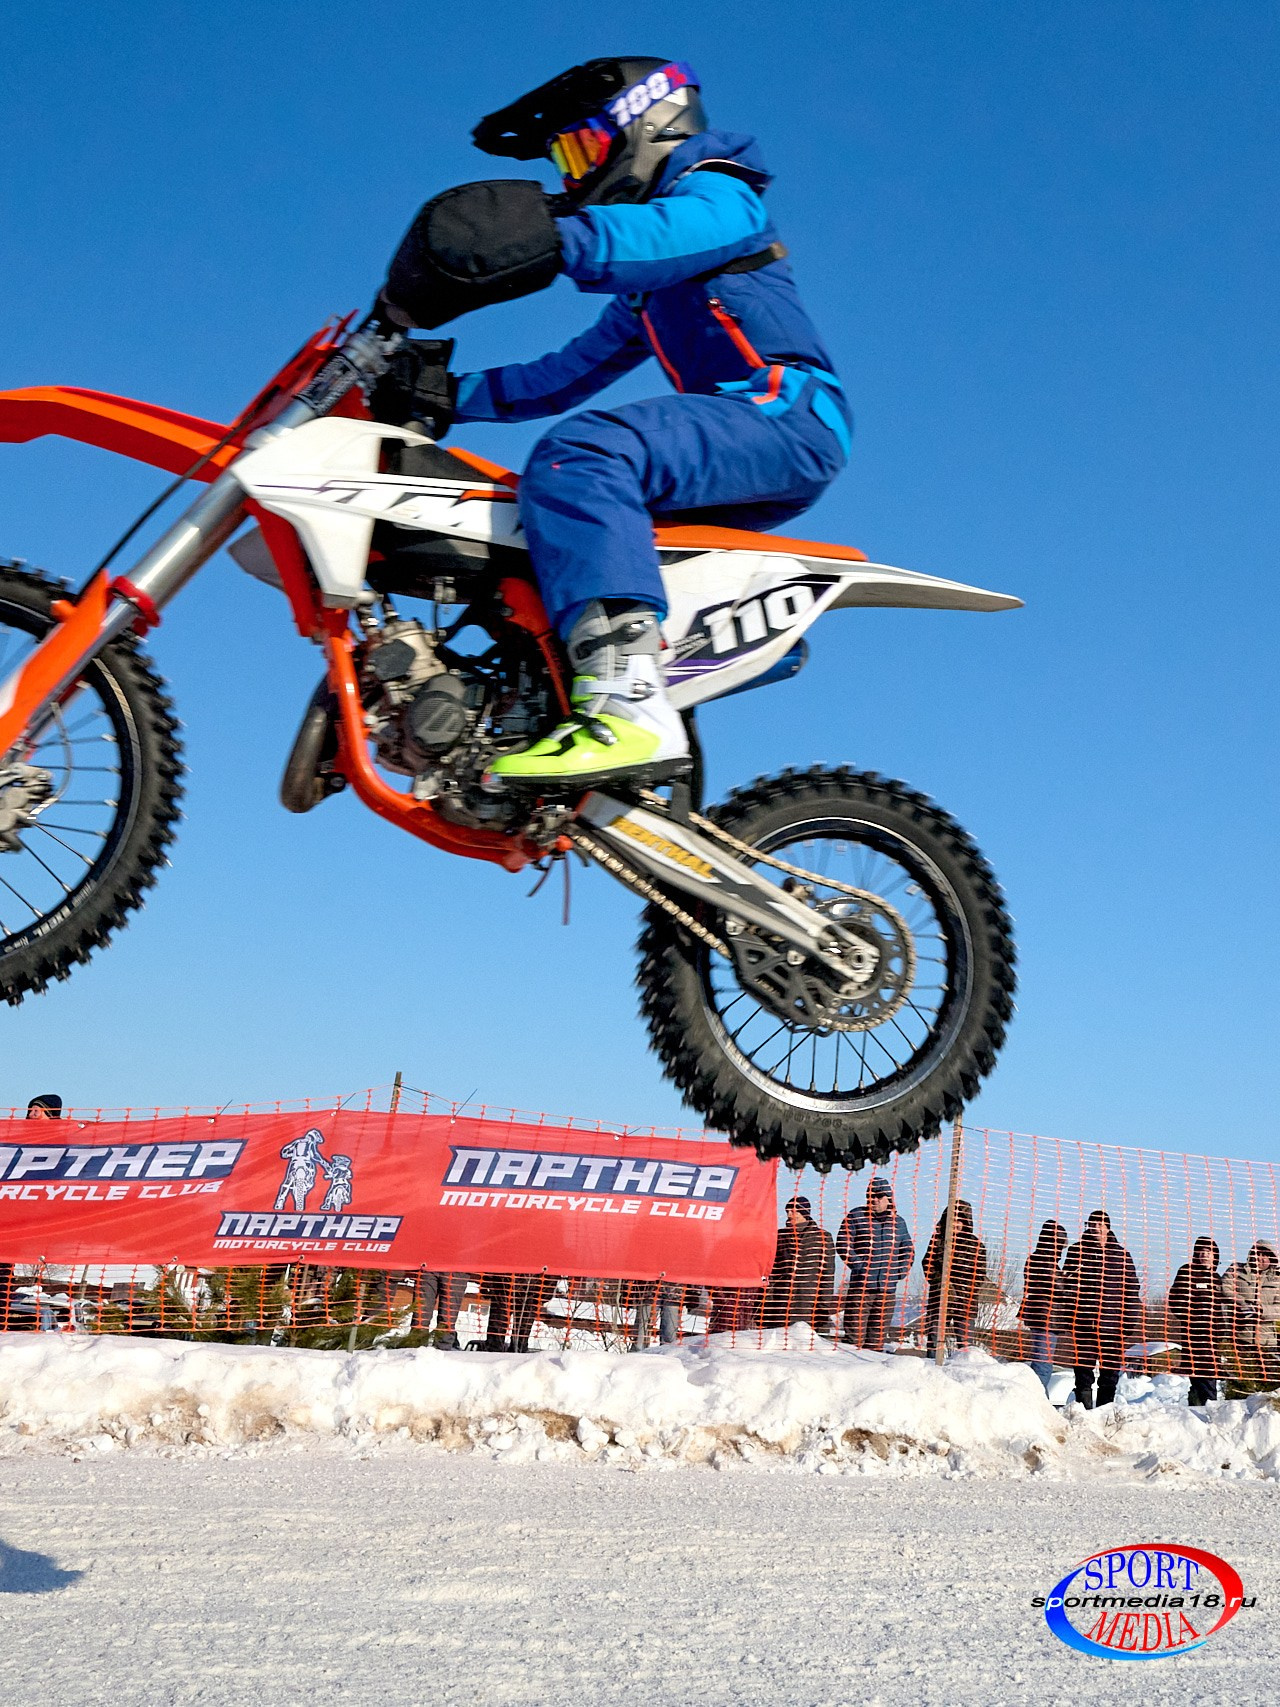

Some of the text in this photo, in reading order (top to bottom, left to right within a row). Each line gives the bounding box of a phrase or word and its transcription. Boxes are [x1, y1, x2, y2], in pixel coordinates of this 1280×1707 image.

[703, 585, 816, 654] 110
[446, 1149, 735, 1197] ПАРТНЕР
[137, 1180, 224, 1199] CLUB
[439, 1191, 725, 1221] MOTORCYCLE CLUB
[217, 1213, 401, 1239] ПАРТНЕР
[213, 1239, 391, 1253] MOTORCYCLE CLUB
